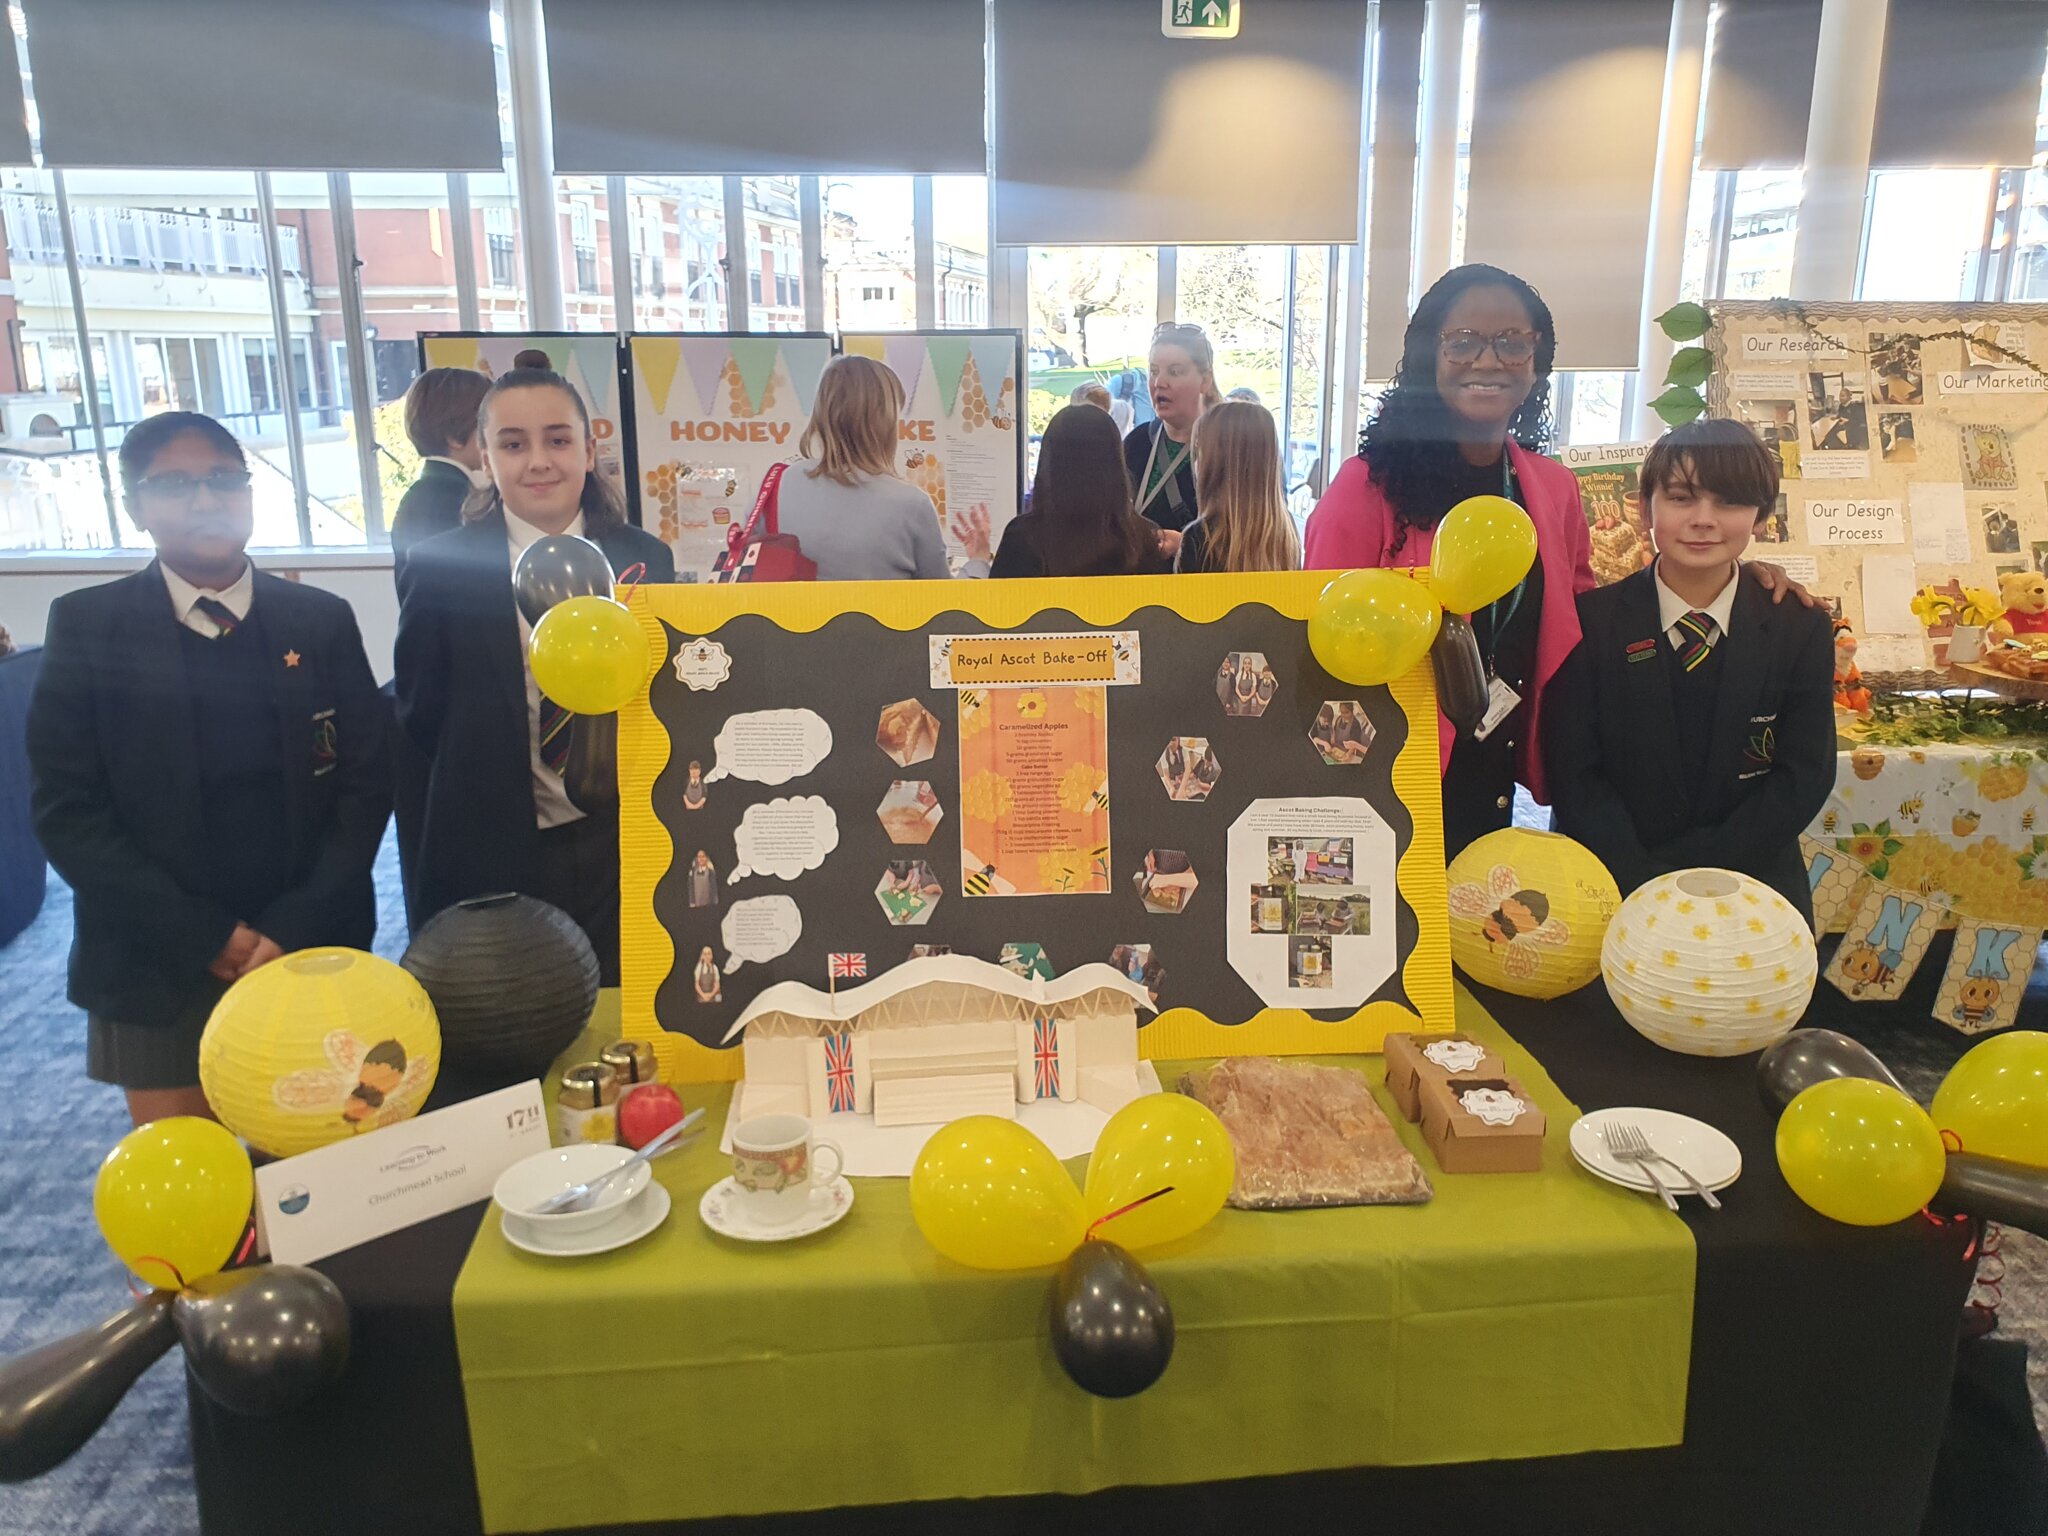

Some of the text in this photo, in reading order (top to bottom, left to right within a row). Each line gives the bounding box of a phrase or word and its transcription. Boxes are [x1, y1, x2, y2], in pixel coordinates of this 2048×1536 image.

[1747, 336, 1844, 352] Our Research
[1943, 374, 1970, 389] Our
[670, 420, 791, 445] HONEY
[898, 419, 936, 441] KE
[1568, 442, 1652, 462] Our Inspirat
[1592, 471, 1625, 483] Birthday
[1585, 482, 1615, 492] Winnie!
[1590, 499, 1621, 520] 100
[1812, 503, 1894, 521] Our Design
[1828, 525, 1883, 540] Process
[957, 650, 1108, 669] Royal Ascot Bake-Off
[999, 723, 1069, 731] Caramelized Apples
[368, 1163, 467, 1205] Churchmead School
